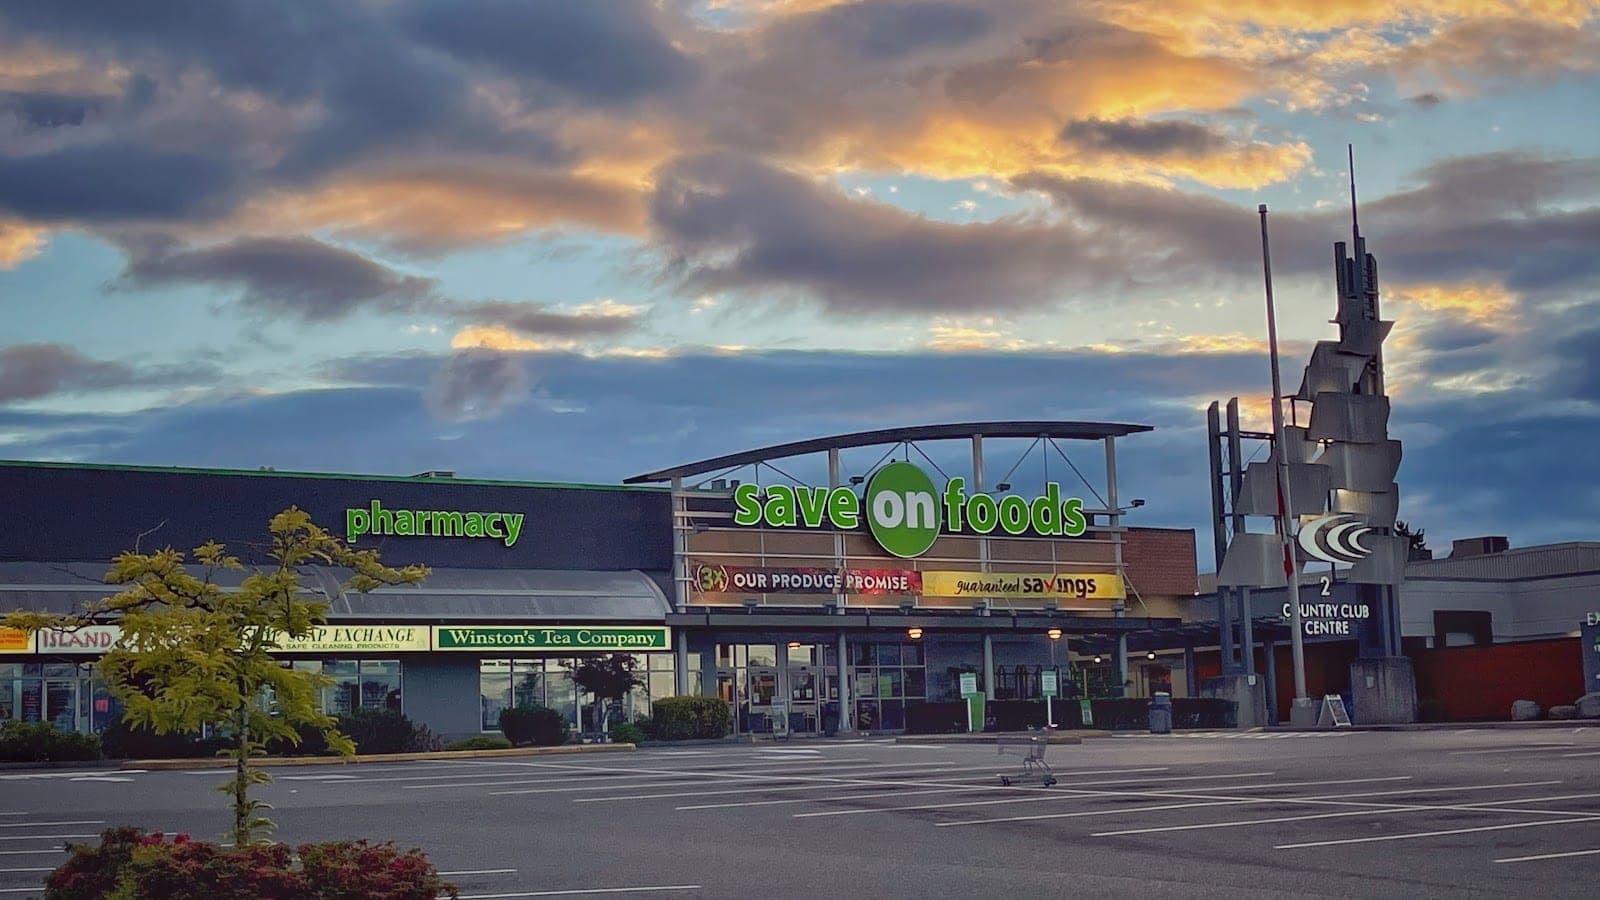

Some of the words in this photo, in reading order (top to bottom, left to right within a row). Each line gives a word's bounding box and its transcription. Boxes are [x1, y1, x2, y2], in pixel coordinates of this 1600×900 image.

[734, 484, 859, 529] save
[873, 491, 935, 529] on
[945, 477, 1087, 537] foods
[346, 500, 524, 546] pharmacy
[734, 575, 767, 588] OUR
[772, 575, 841, 589] PRODUCE
[846, 576, 908, 590] PROMISE
[954, 575, 1020, 595] guaranteed
[1320, 576, 1331, 596] 2
[1283, 603, 1338, 618] CUNTRY
[1341, 604, 1370, 618] CLUB
[333, 628, 416, 642] EXCHANGE
[1305, 620, 1349, 635] CENTRE
[43, 631, 111, 648] ISLAND
[448, 630, 536, 645] Winston's
[540, 630, 571, 645] Tea
[576, 630, 657, 647] Company
